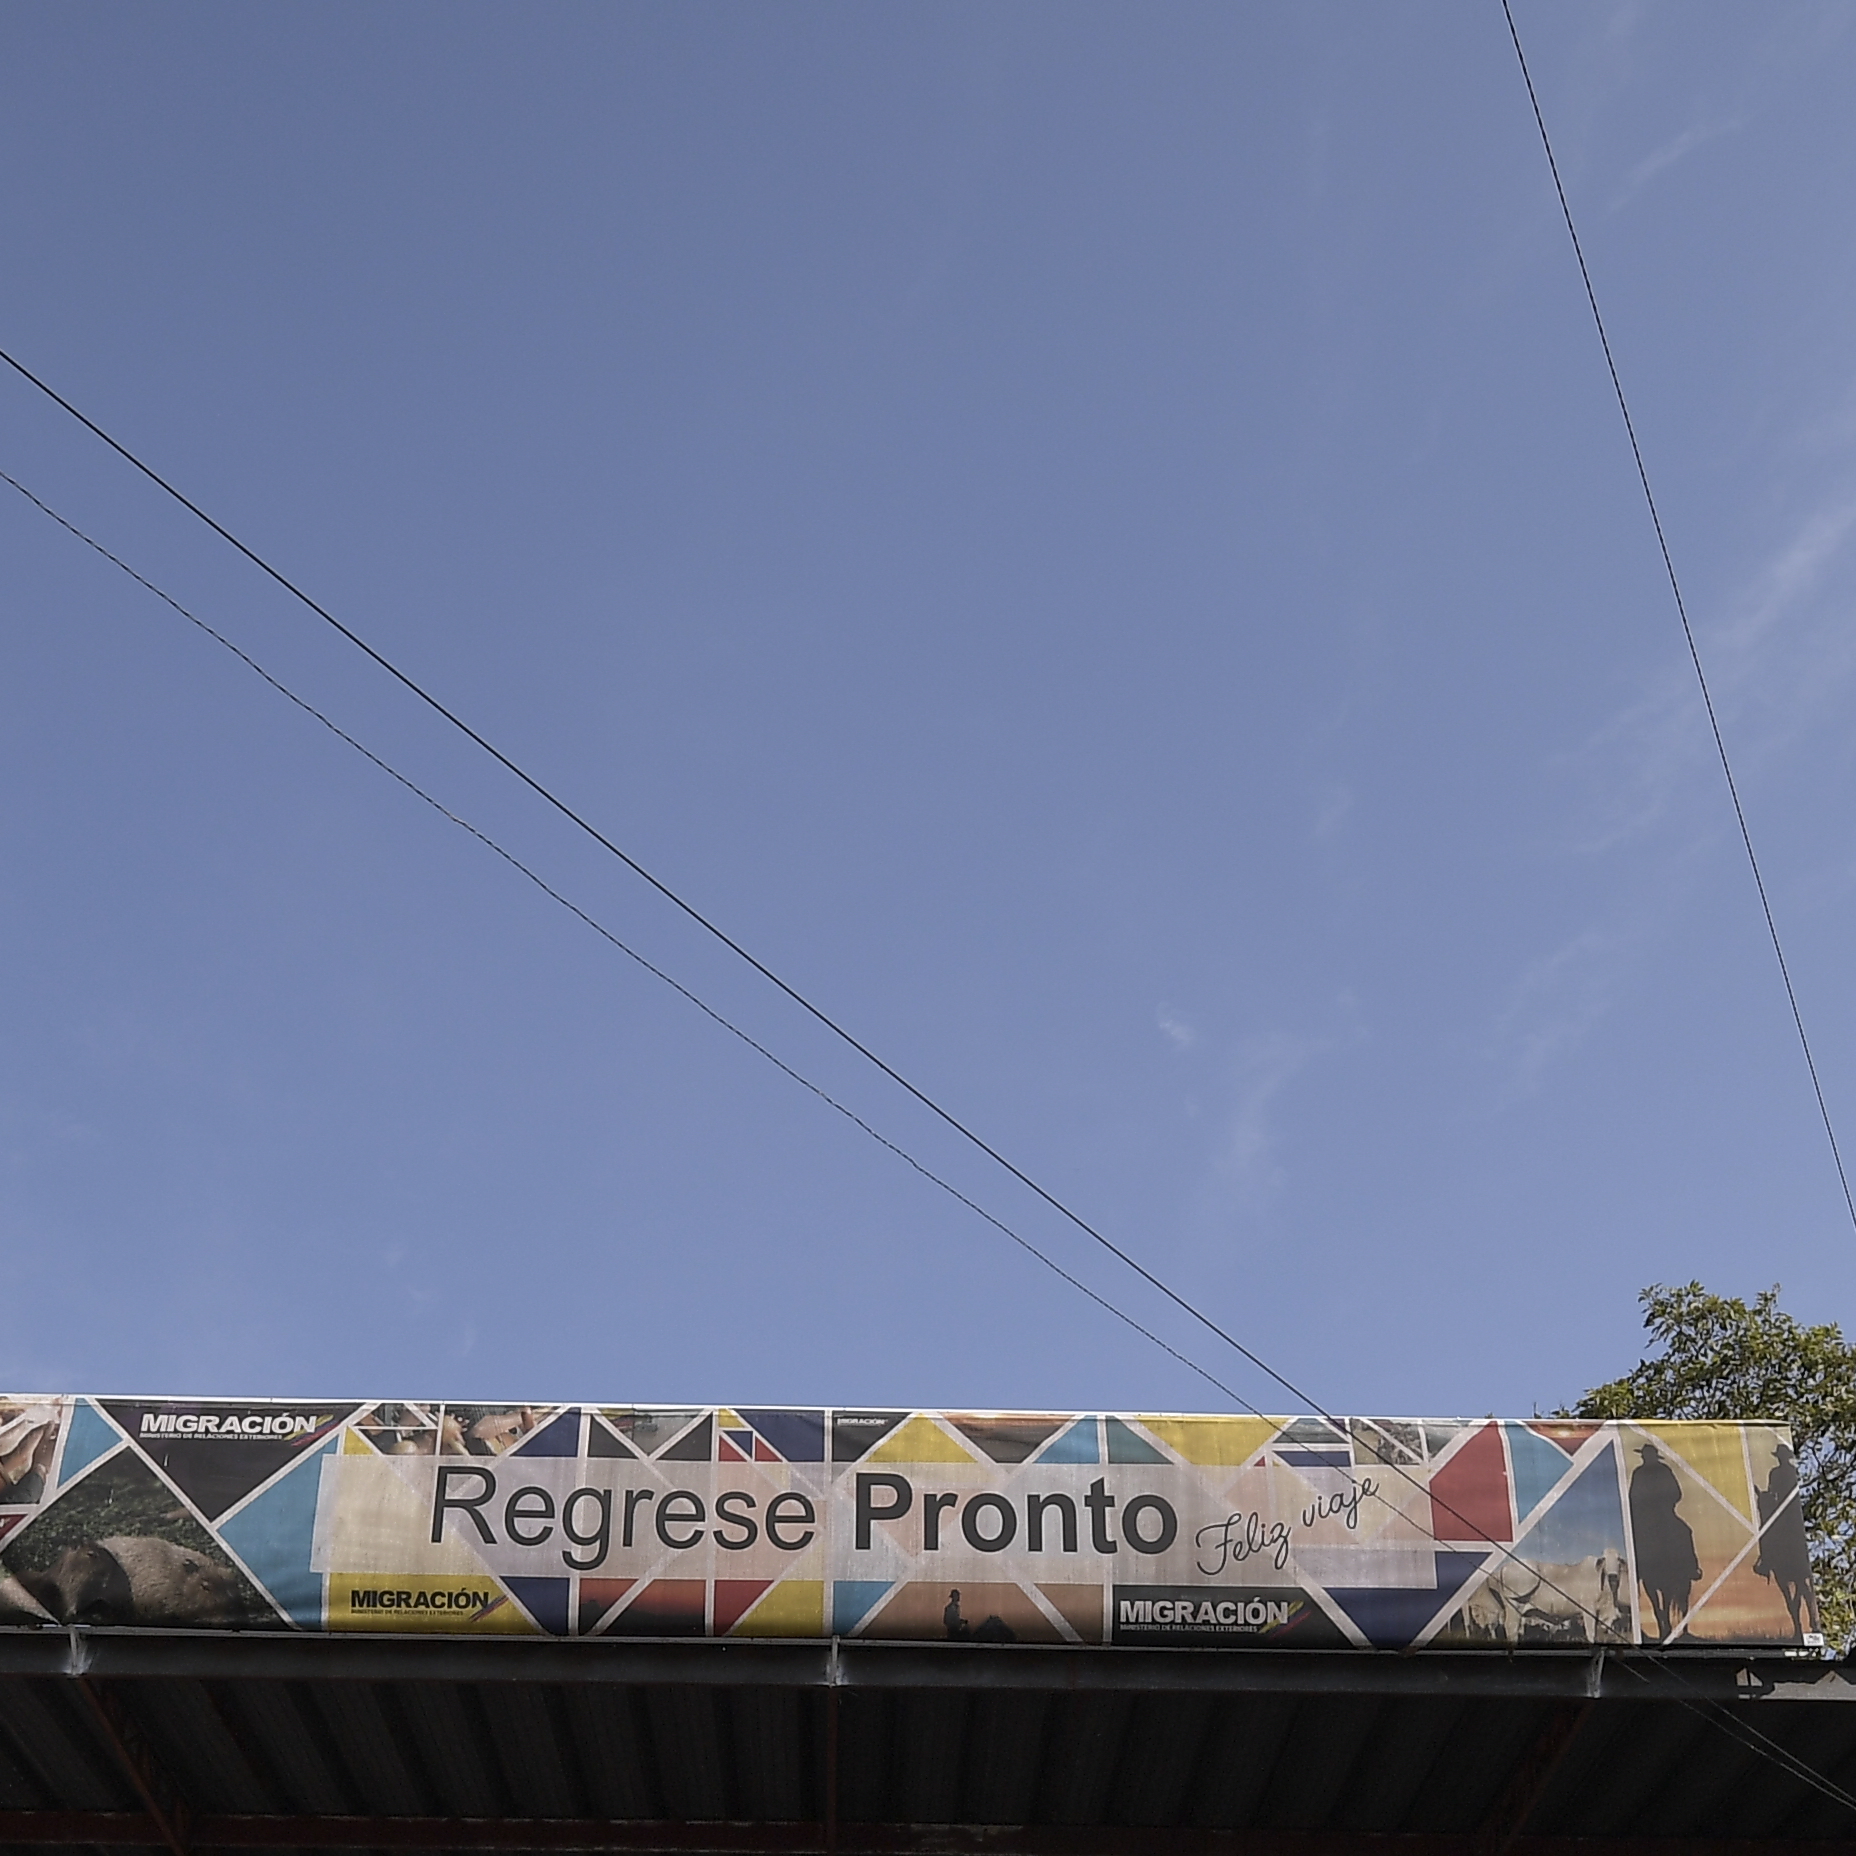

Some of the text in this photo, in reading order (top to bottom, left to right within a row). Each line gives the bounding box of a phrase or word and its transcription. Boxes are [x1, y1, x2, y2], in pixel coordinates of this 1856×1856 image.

[140, 1412, 317, 1434] MIGRACIÓN
[430, 1465, 1178, 1571] Regrese Pronto
[1195, 1477, 1380, 1575] Feliz viaje
[351, 1588, 489, 1609] MIGRACIÓN
[1120, 1597, 1289, 1624] MIGRACIÓN
